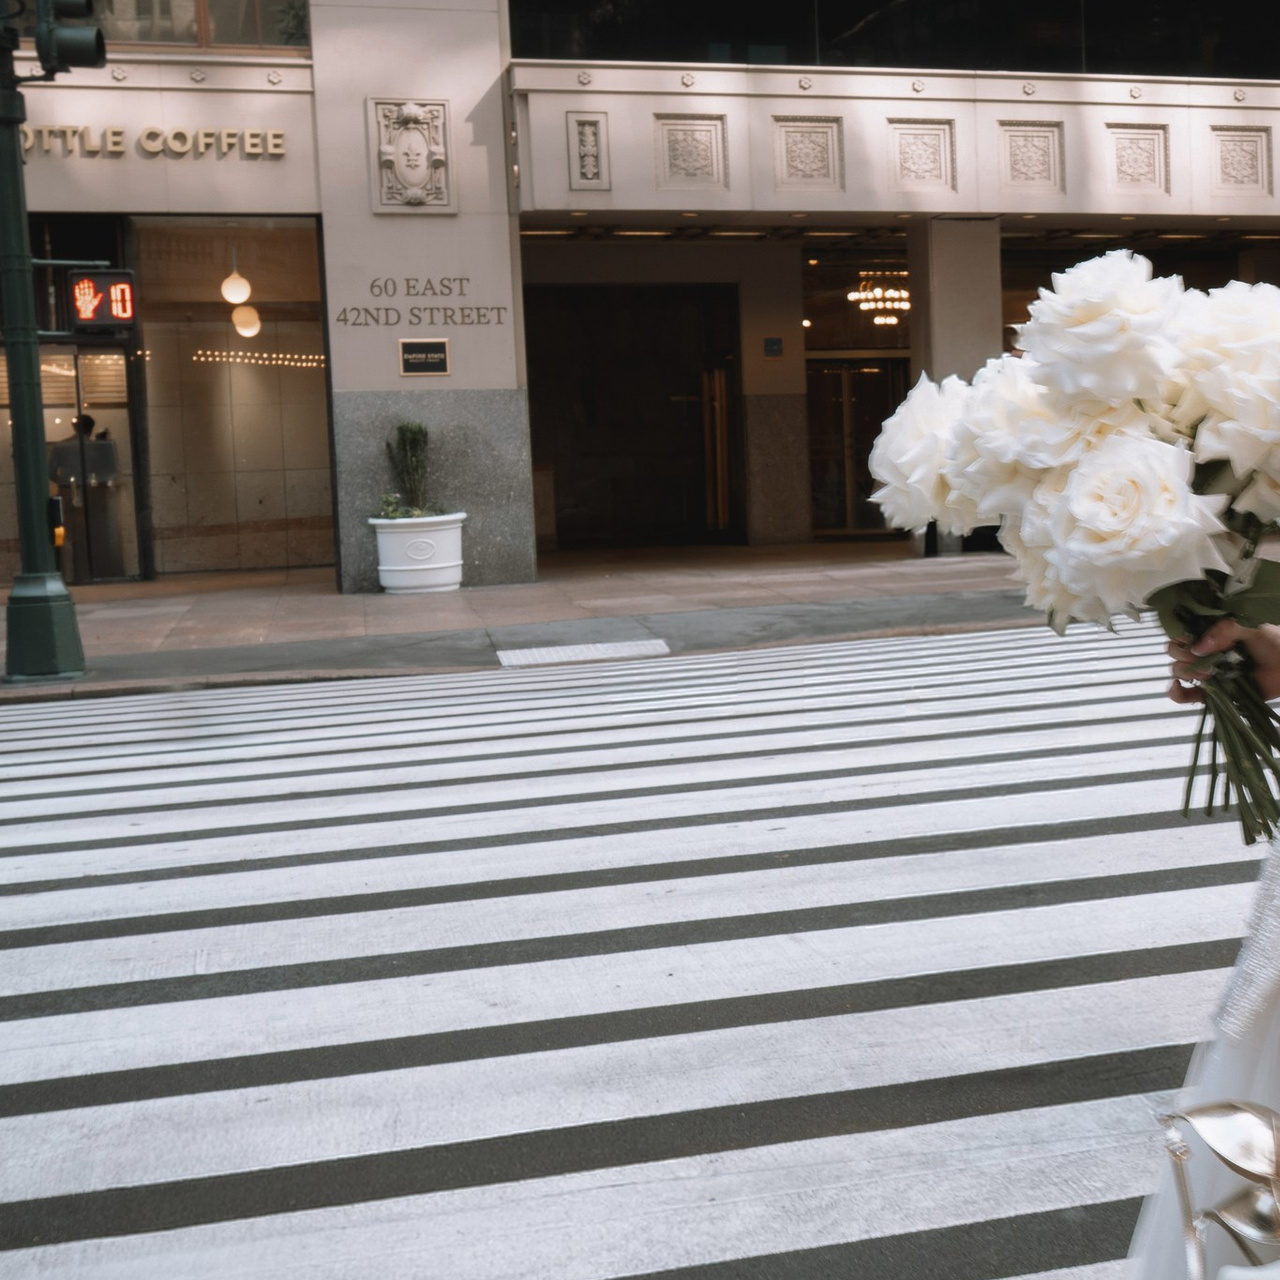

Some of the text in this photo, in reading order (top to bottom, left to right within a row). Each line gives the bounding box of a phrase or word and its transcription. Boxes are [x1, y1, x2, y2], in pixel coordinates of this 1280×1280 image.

[139, 126, 286, 156] COFFEE
[369, 277, 470, 297] 60 EAST
[110, 283, 133, 319] 10
[336, 306, 508, 327] 42ND STREET
